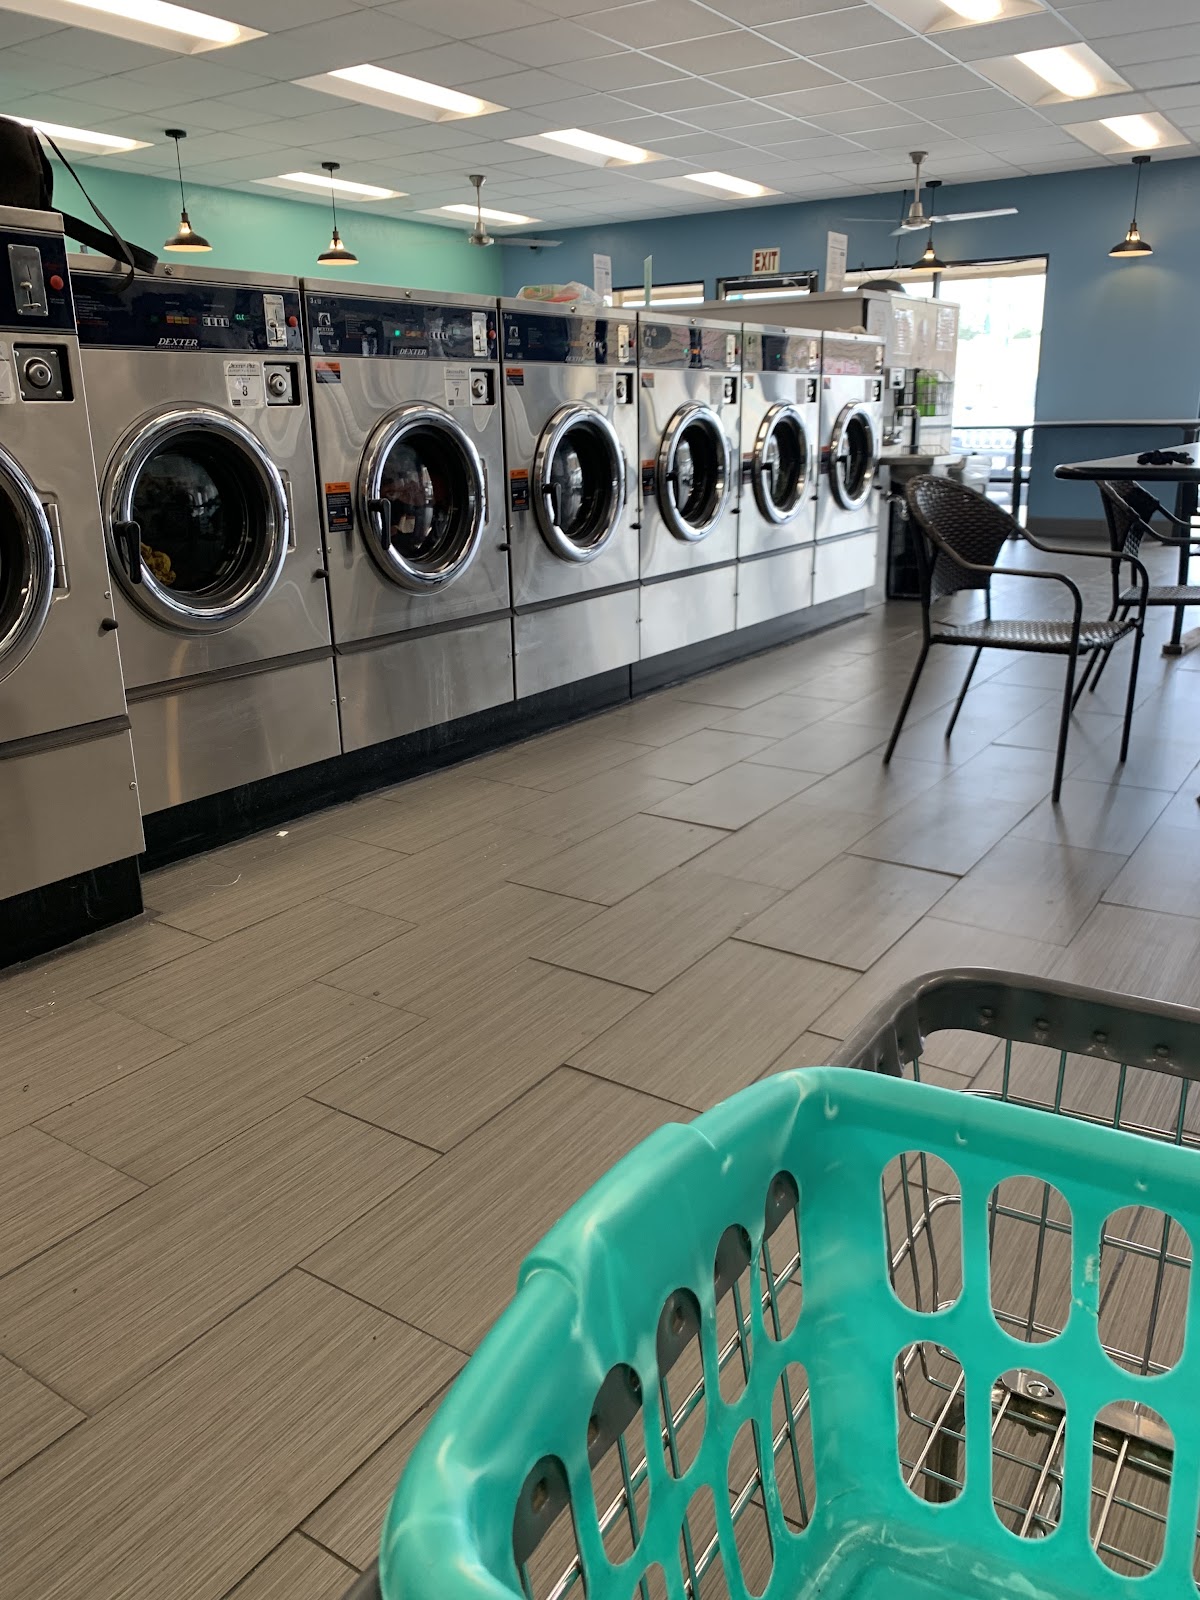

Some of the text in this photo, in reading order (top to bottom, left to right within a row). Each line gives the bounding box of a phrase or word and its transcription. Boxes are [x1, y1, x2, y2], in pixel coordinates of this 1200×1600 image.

[754, 251, 777, 271] EXIT
[158, 337, 198, 347] DEXTER
[399, 348, 427, 356] DEXTER
[242, 385, 248, 397] 8
